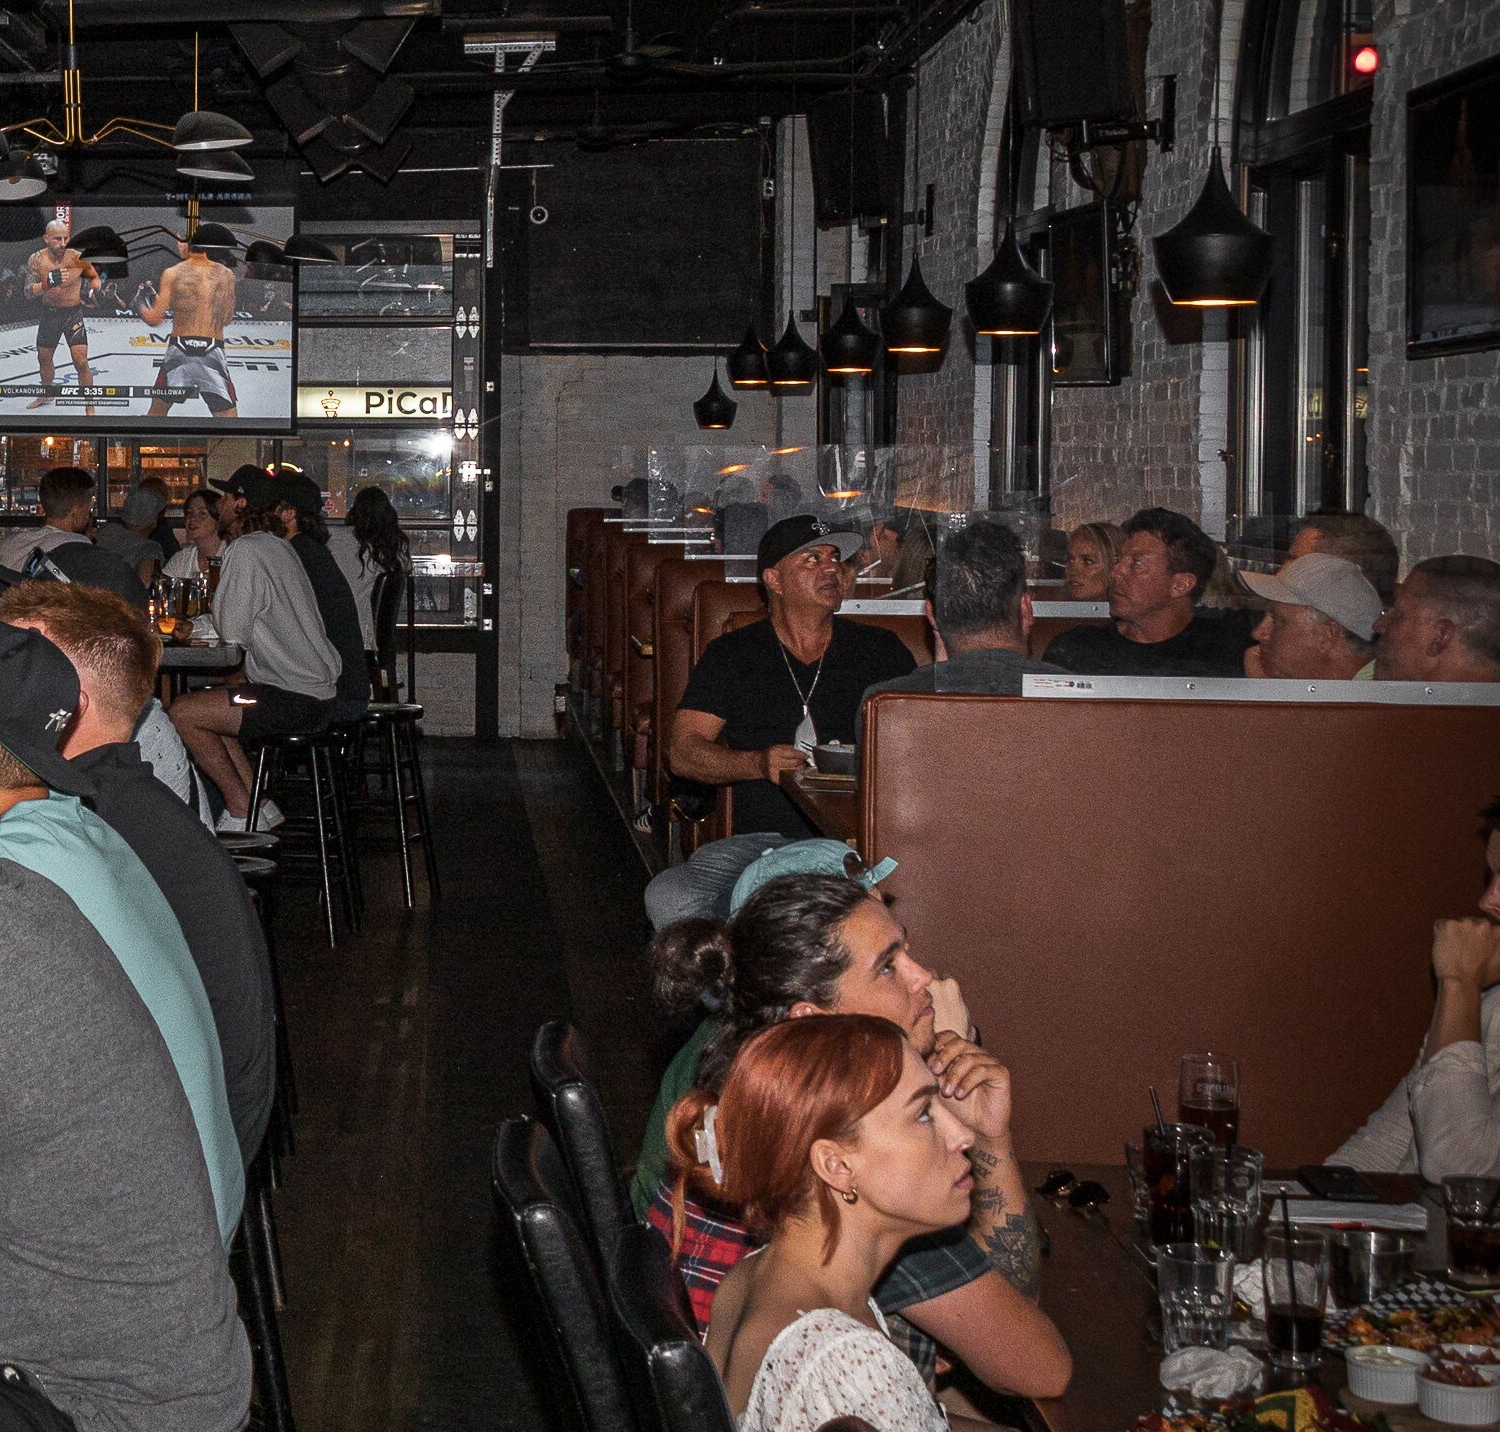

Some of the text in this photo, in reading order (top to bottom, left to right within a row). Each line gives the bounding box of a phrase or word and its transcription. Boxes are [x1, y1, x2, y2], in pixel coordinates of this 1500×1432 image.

[61, 387, 80, 396] UFC
[84, 387, 104, 396] 3:35
[151, 388, 187, 396] HOLLOWAY
